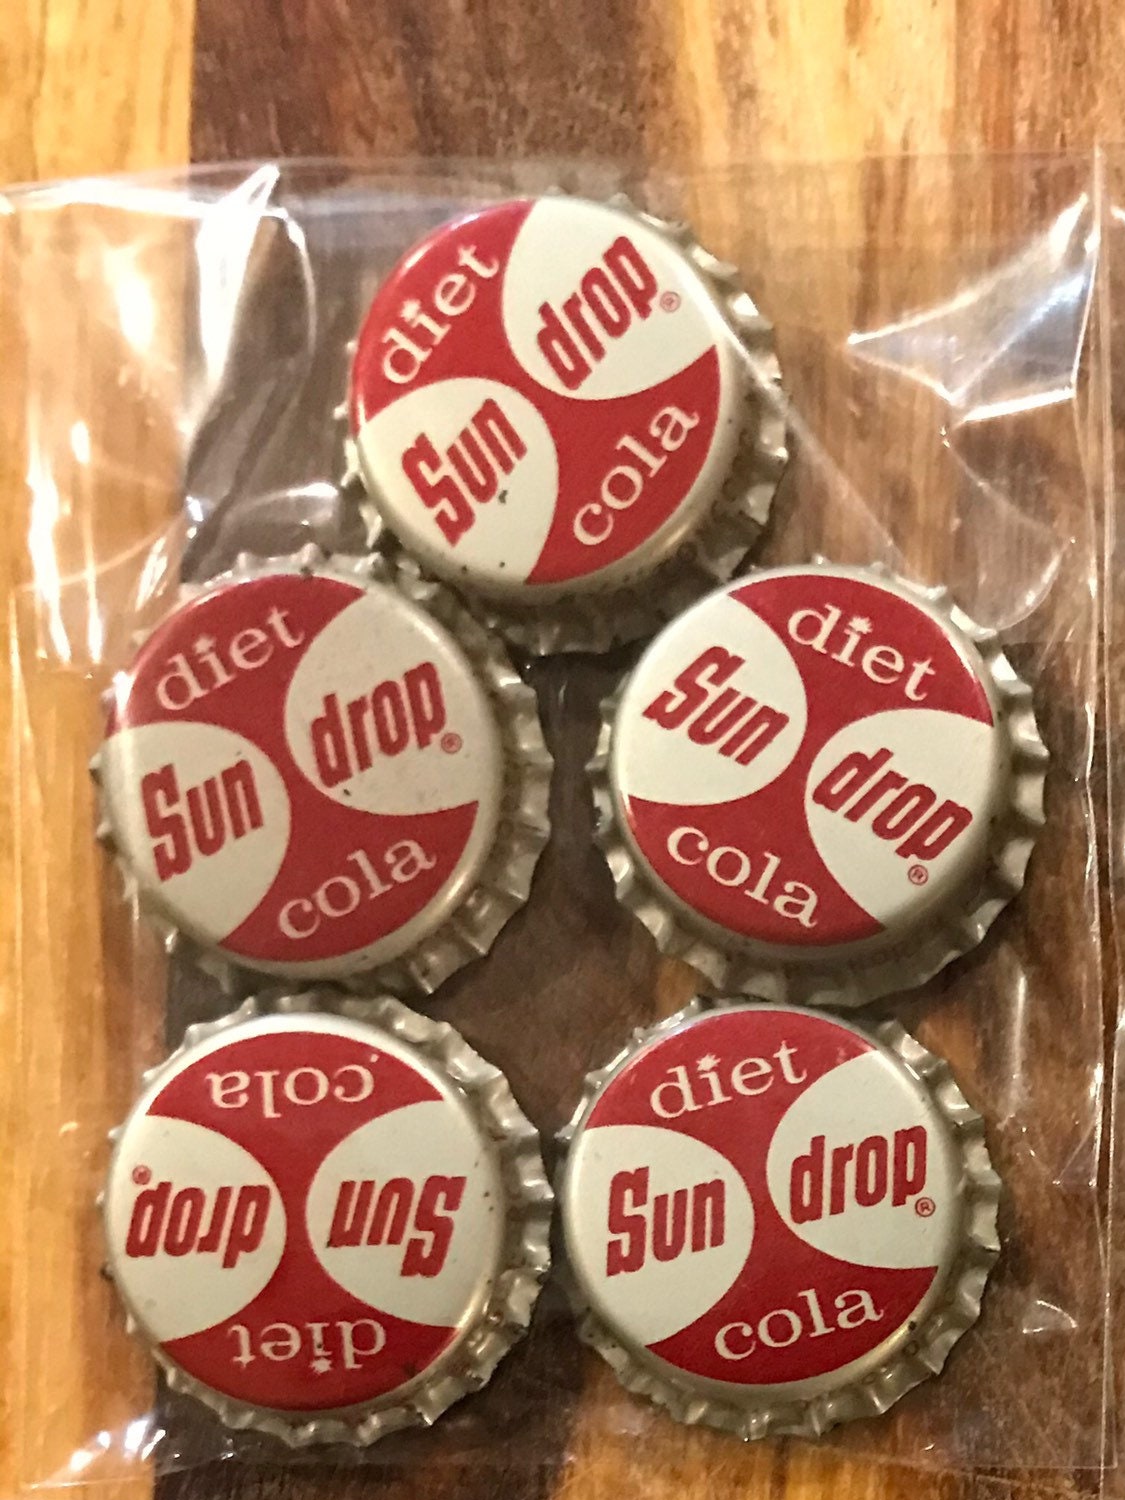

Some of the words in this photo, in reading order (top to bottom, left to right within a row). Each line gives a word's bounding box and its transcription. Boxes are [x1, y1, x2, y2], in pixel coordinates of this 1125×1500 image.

[383, 245, 499, 384] diet
[402, 399, 528, 546] Sun
[537, 236, 657, 390] drop
[573, 406, 700, 545] cola
[156, 606, 305, 710] diet
[787, 603, 936, 701] diet
[141, 759, 264, 882] Sun
[310, 661, 446, 788] drop
[642, 646, 789, 766] Sun
[812, 747, 973, 861] drop
[277, 838, 436, 938] cola
[667, 826, 818, 928] cola
[206, 1065, 375, 1118] cola
[649, 1040, 807, 1119] diet
[125, 1182, 270, 1269] drop
[326, 1175, 466, 1278] Sun
[606, 1166, 726, 1276] Sun
[789, 1125, 927, 1225] drop
[227, 1318, 386, 1374] diet
[714, 1288, 884, 1361] cola
